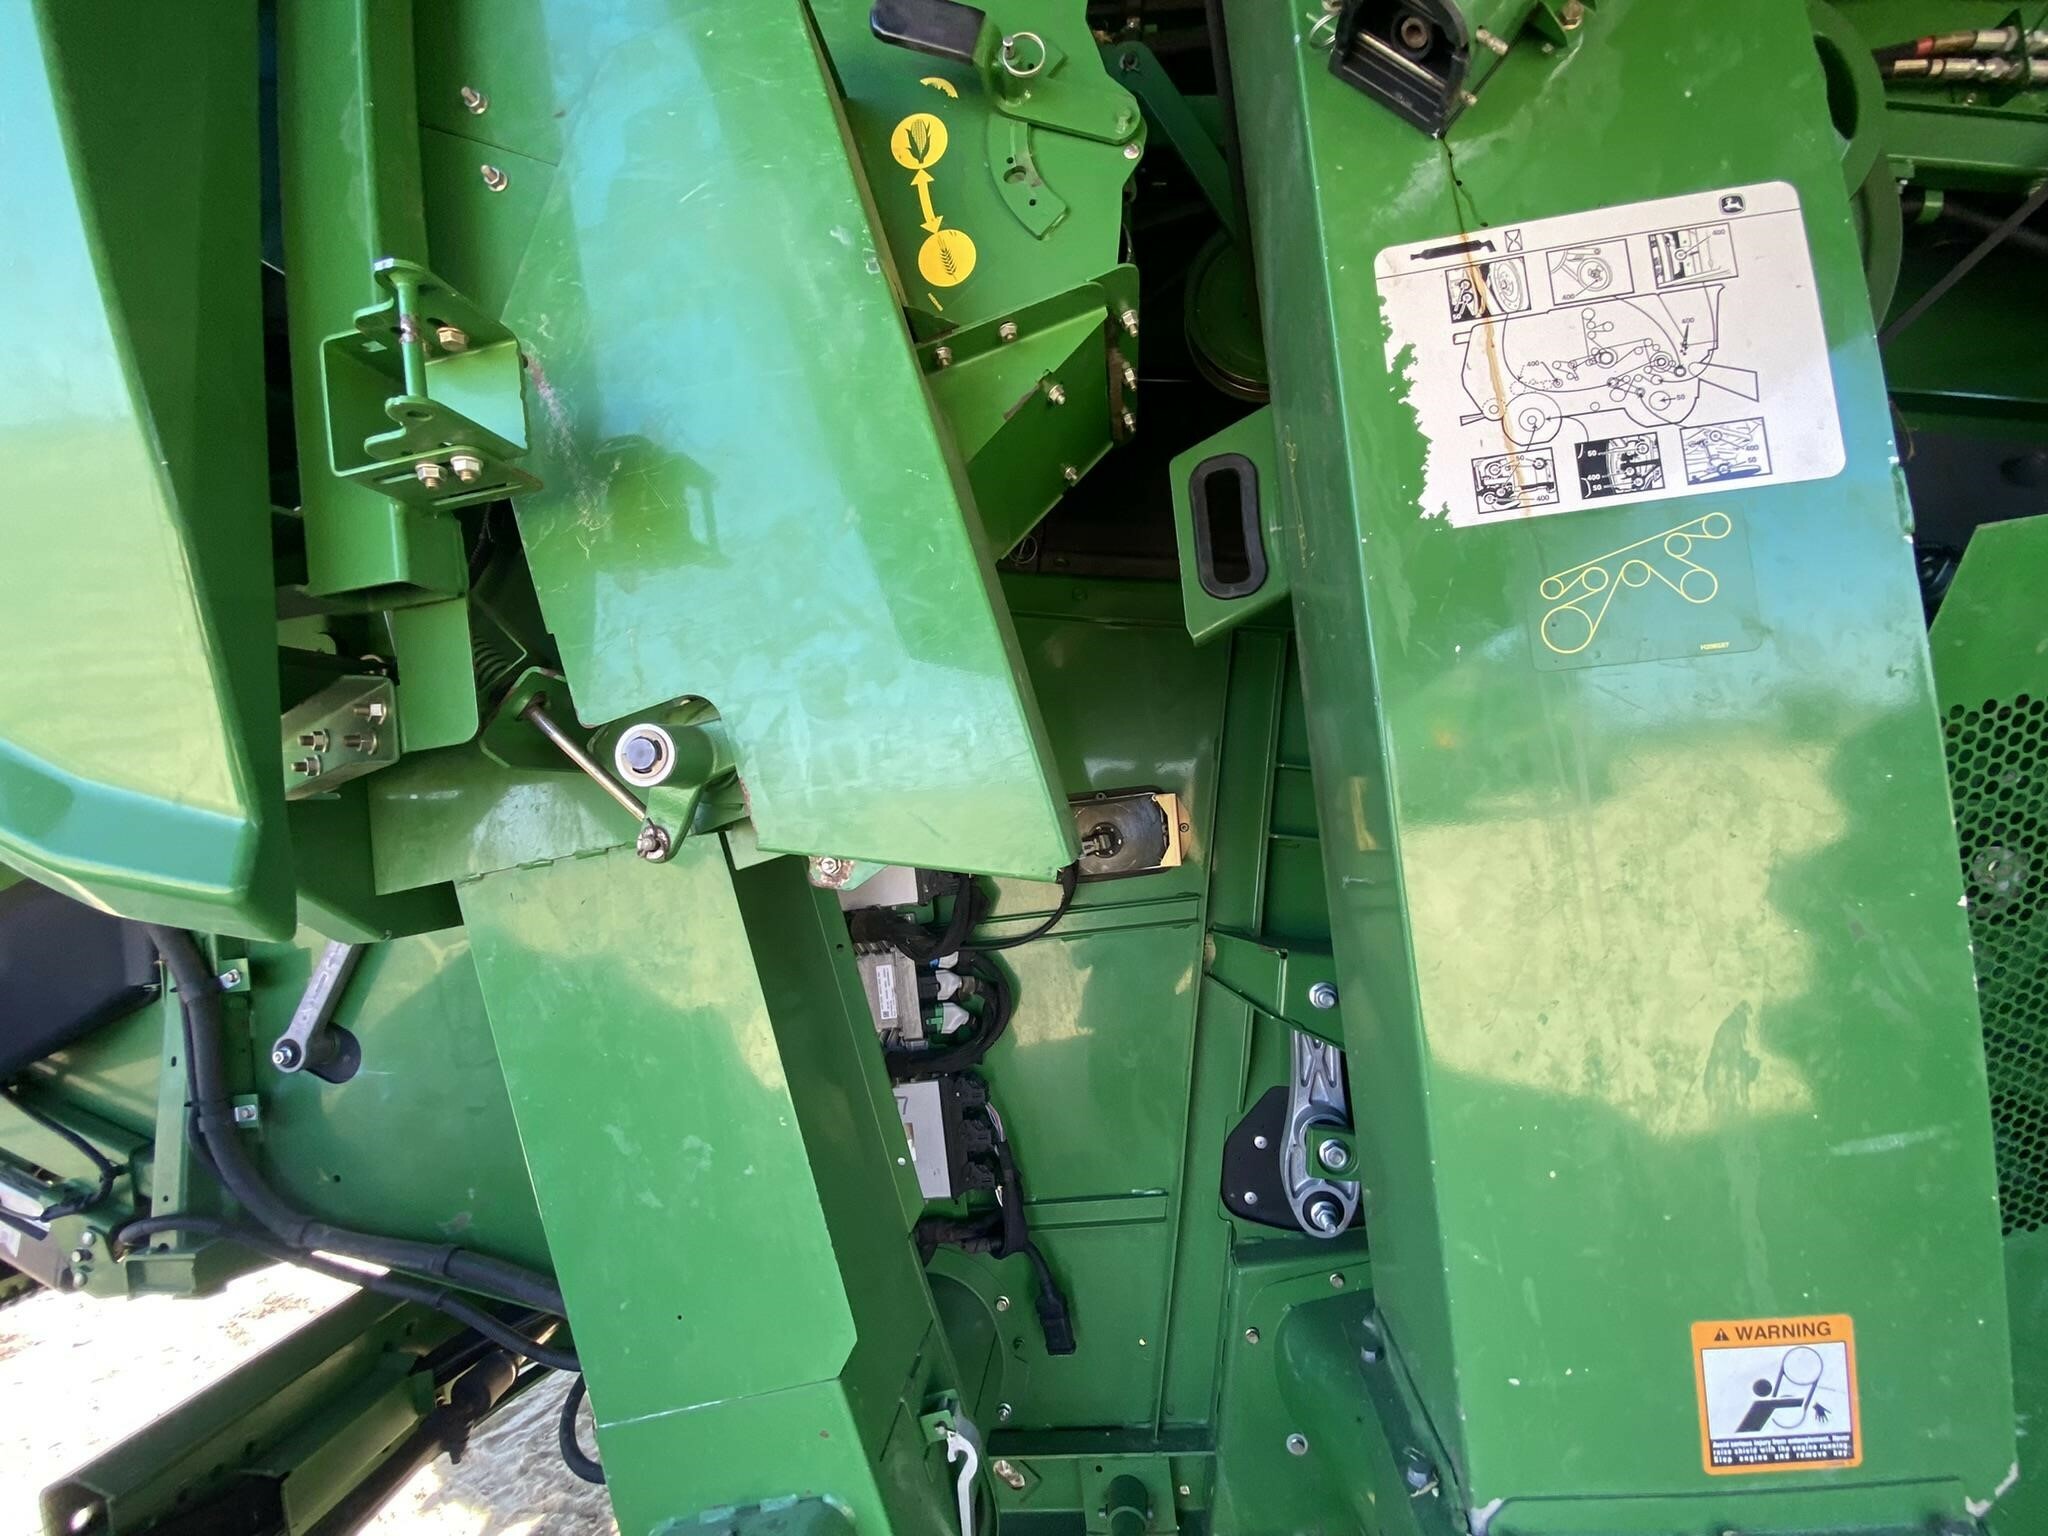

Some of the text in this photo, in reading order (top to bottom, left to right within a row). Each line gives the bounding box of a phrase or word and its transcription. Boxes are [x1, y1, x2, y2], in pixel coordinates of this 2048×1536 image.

[1735, 1321, 1831, 1341] WARNING
[1713, 1441, 1851, 1456] raise shield with the engine running.
[1713, 1448, 1851, 1464] Stop engine and remove key.
